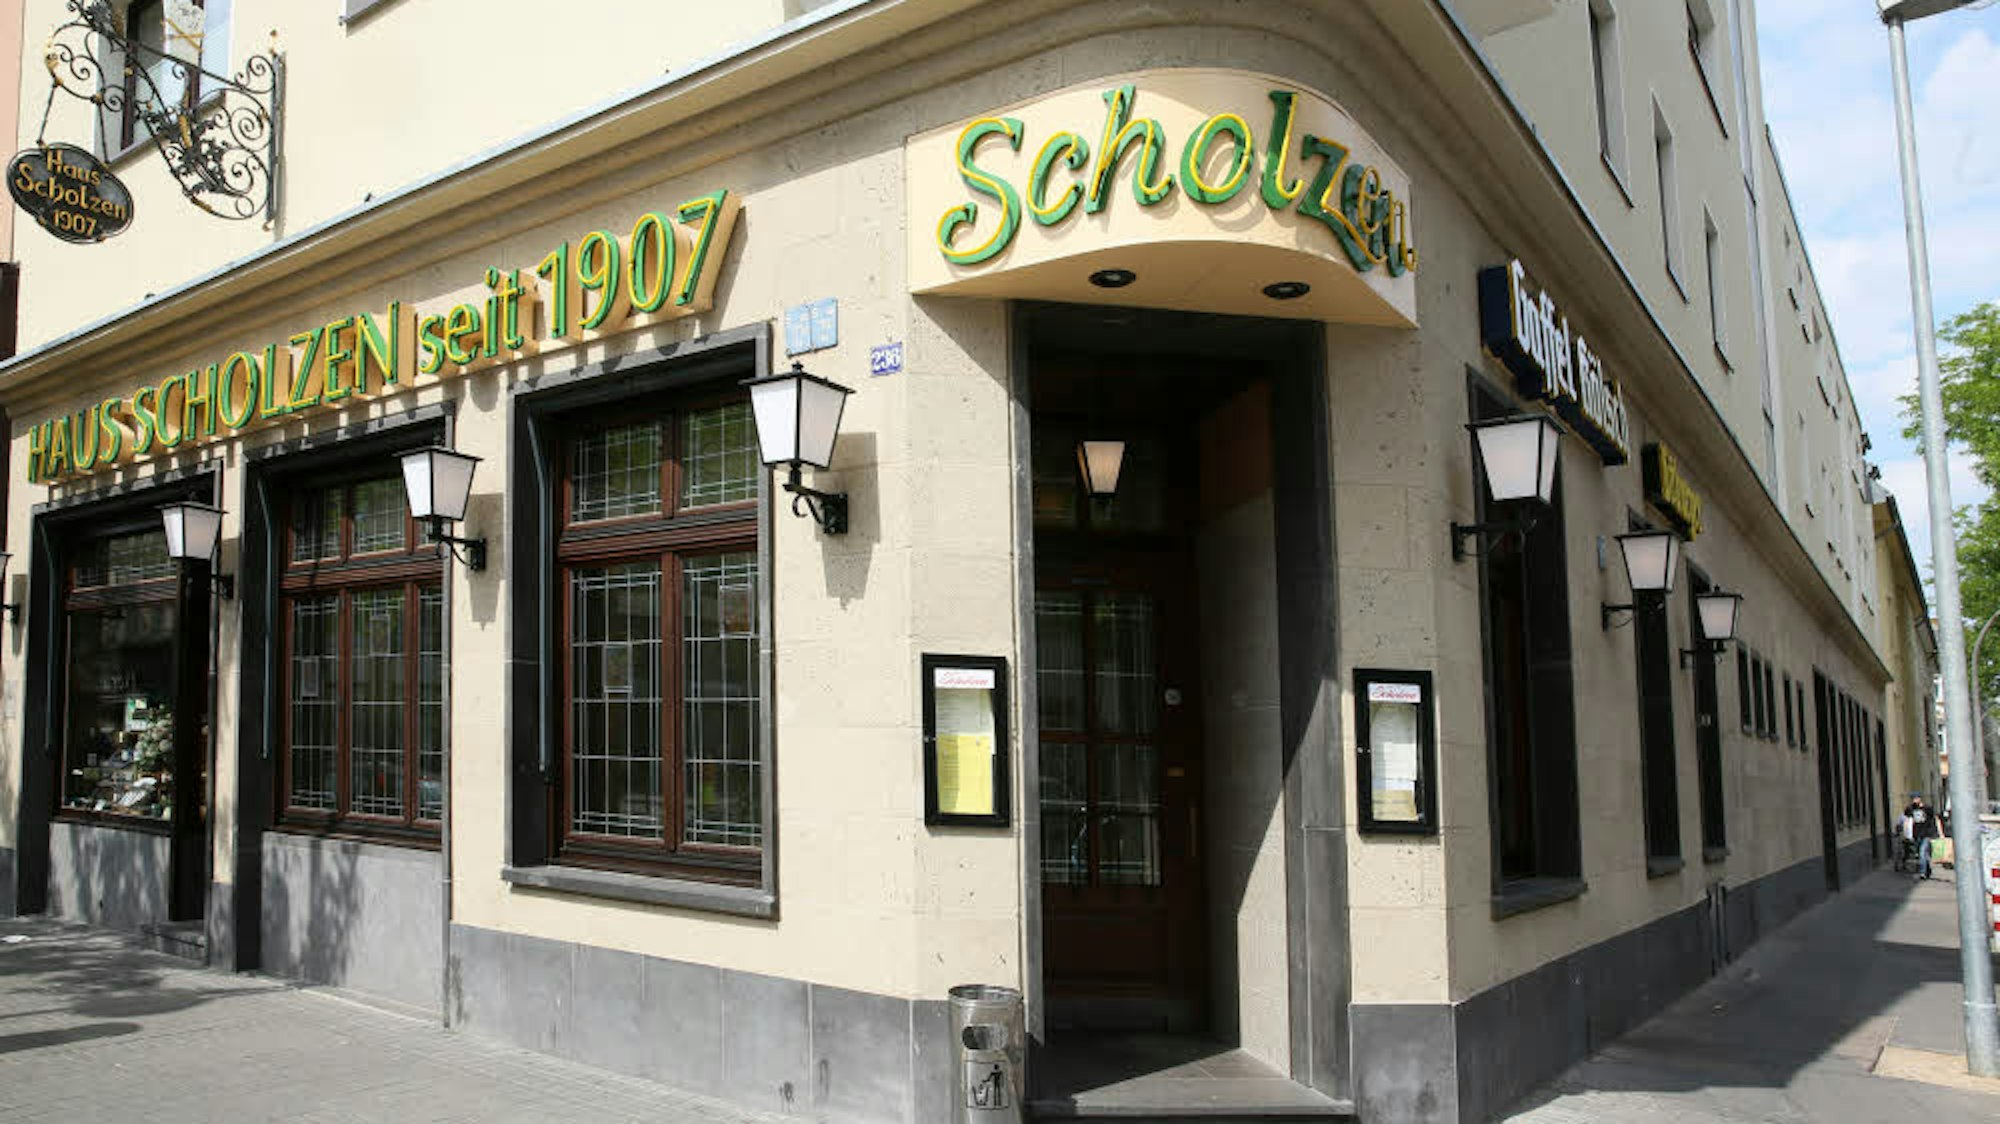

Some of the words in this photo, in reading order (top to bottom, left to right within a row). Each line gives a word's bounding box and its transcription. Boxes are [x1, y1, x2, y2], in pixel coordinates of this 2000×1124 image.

[16, 162, 127, 220] Scholzen
[46, 149, 101, 186] Haus
[937, 84, 1416, 278] Scholzen
[53, 209, 97, 236] 1907
[28, 397, 122, 484] HAUS
[131, 300, 399, 455] SCHOLZEN
[418, 265, 525, 374] seit
[536, 189, 728, 340] 1907
[1511, 258, 1577, 402] Gaffel
